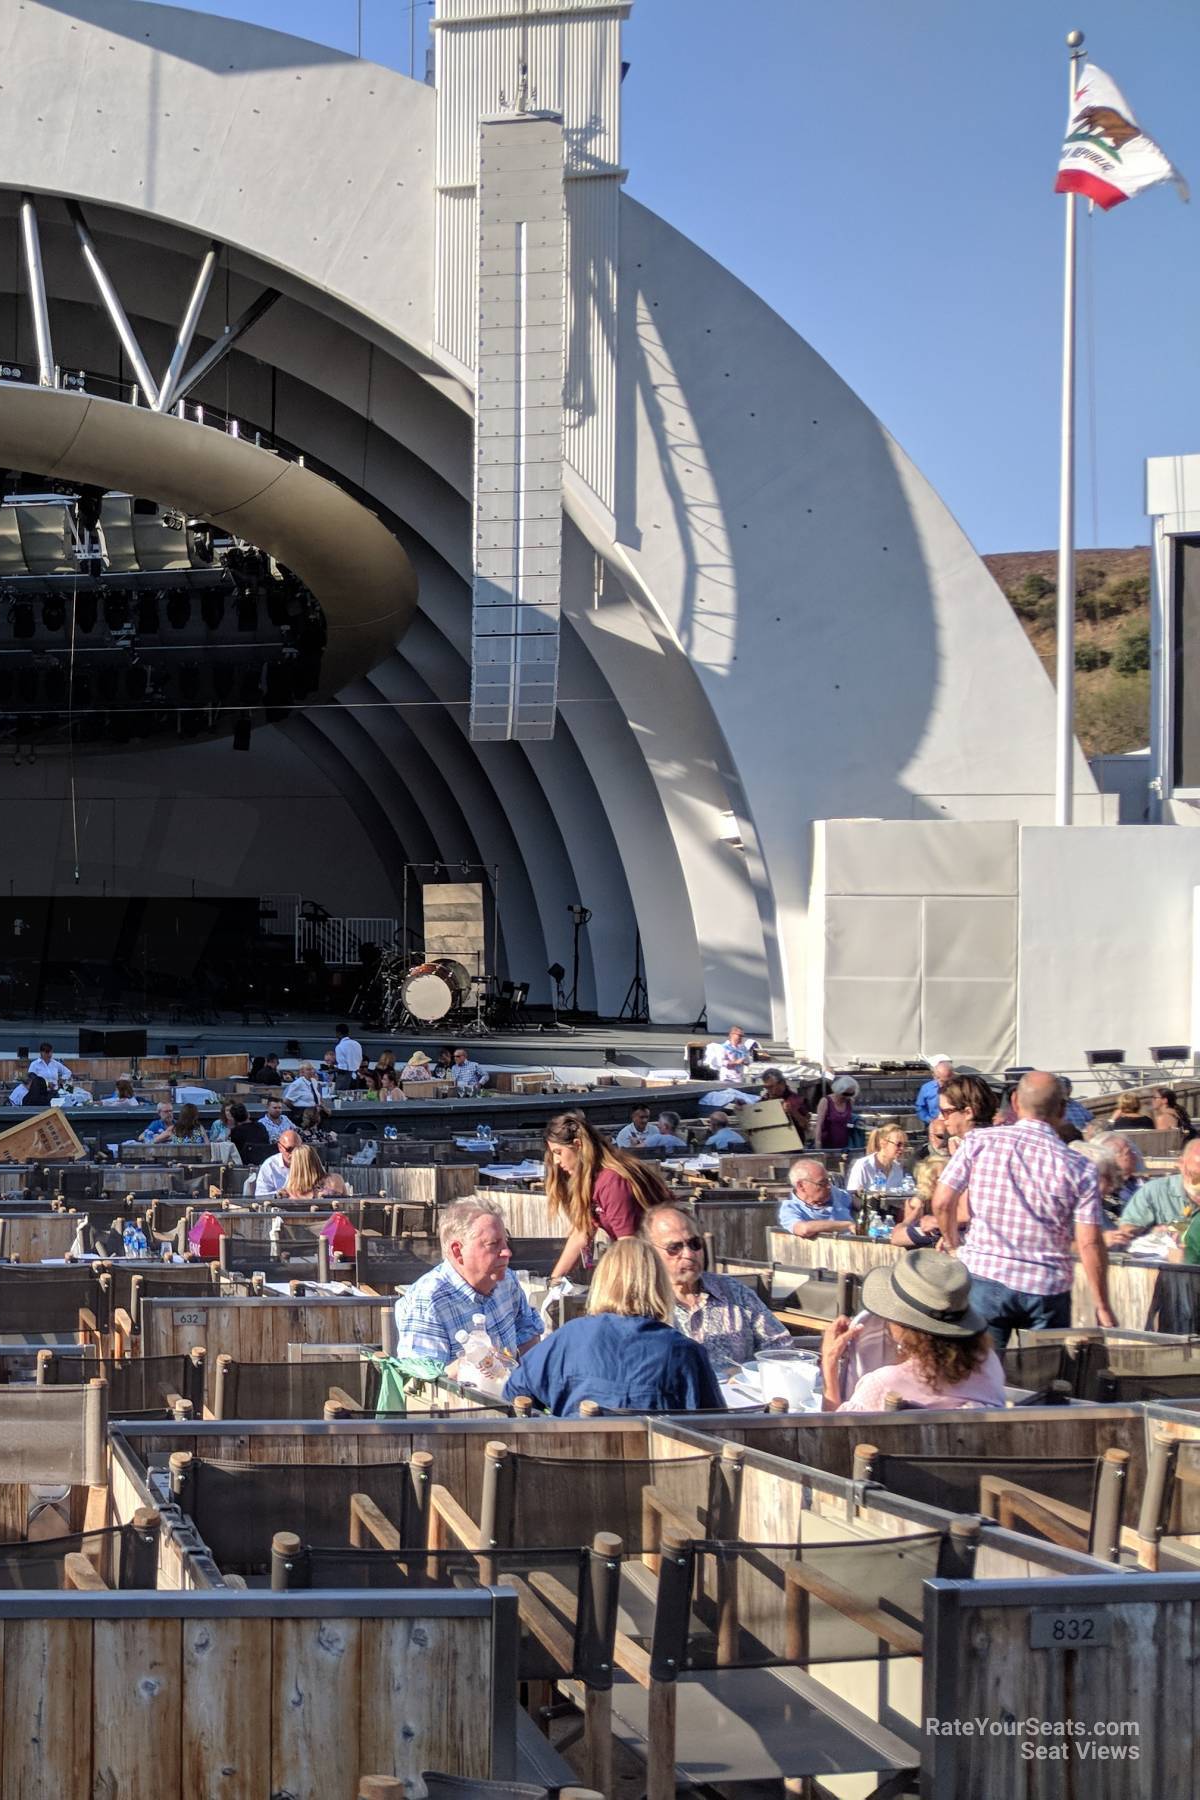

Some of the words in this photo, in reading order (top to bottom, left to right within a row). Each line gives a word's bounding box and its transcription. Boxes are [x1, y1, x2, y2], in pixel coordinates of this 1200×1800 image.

[1071, 147, 1115, 171] REPUBLIC
[180, 1313, 198, 1323] 632
[1052, 1618, 1096, 1640] 832
